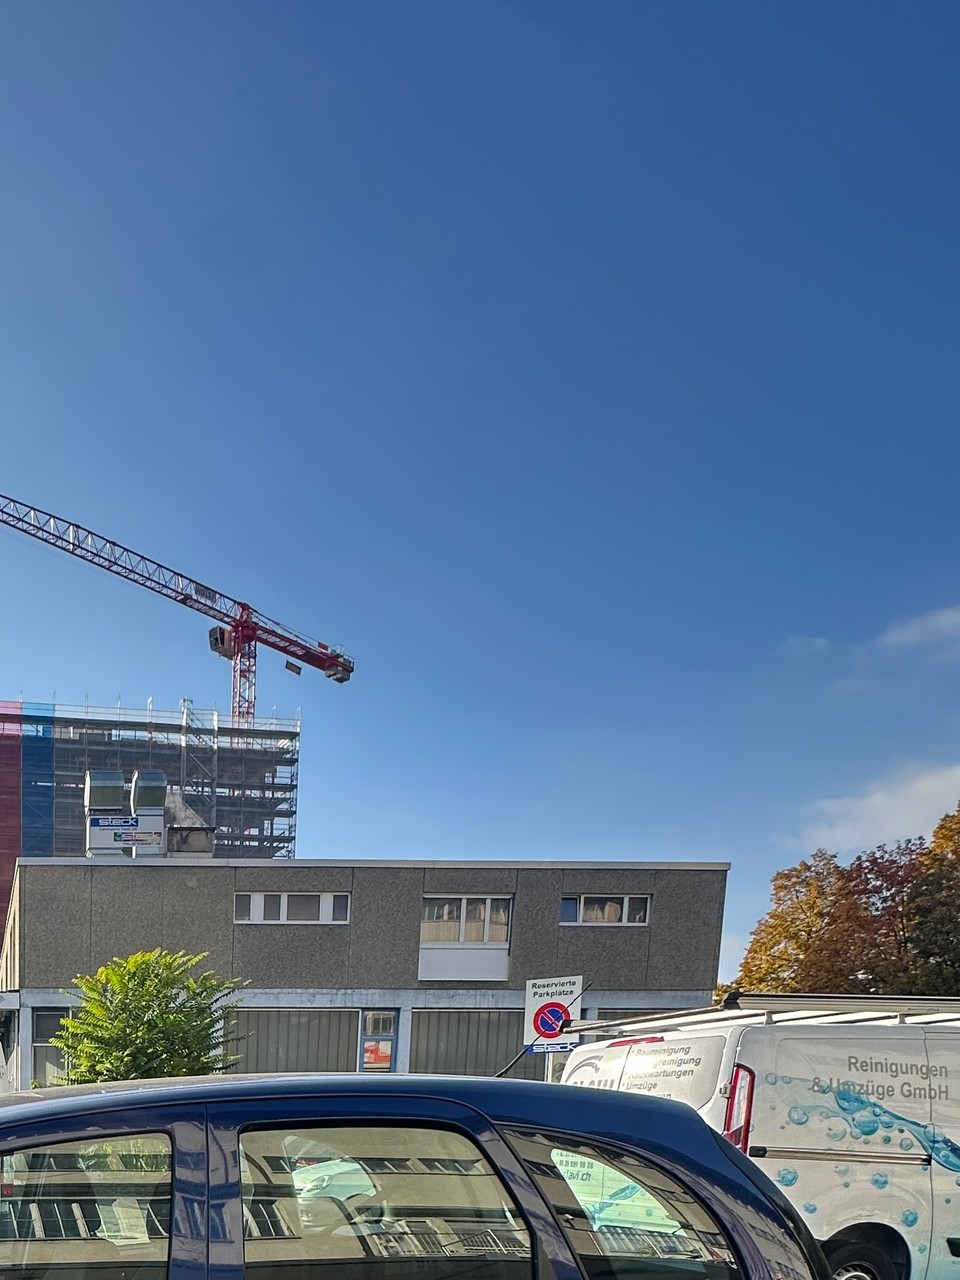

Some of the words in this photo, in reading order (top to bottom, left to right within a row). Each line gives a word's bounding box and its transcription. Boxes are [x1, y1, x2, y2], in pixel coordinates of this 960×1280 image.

[98, 818, 137, 826] steck
[531, 980, 577, 990] Reservierte
[533, 989, 574, 998] Parkplätze
[532, 1043, 577, 1053] steck
[848, 1056, 948, 1080] Reinigungen
[626, 1081, 658, 1091] Umzüge
[811, 1076, 822, 1093] &
[830, 1077, 895, 1100] Umzüge
[900, 1081, 949, 1101] GmbH
